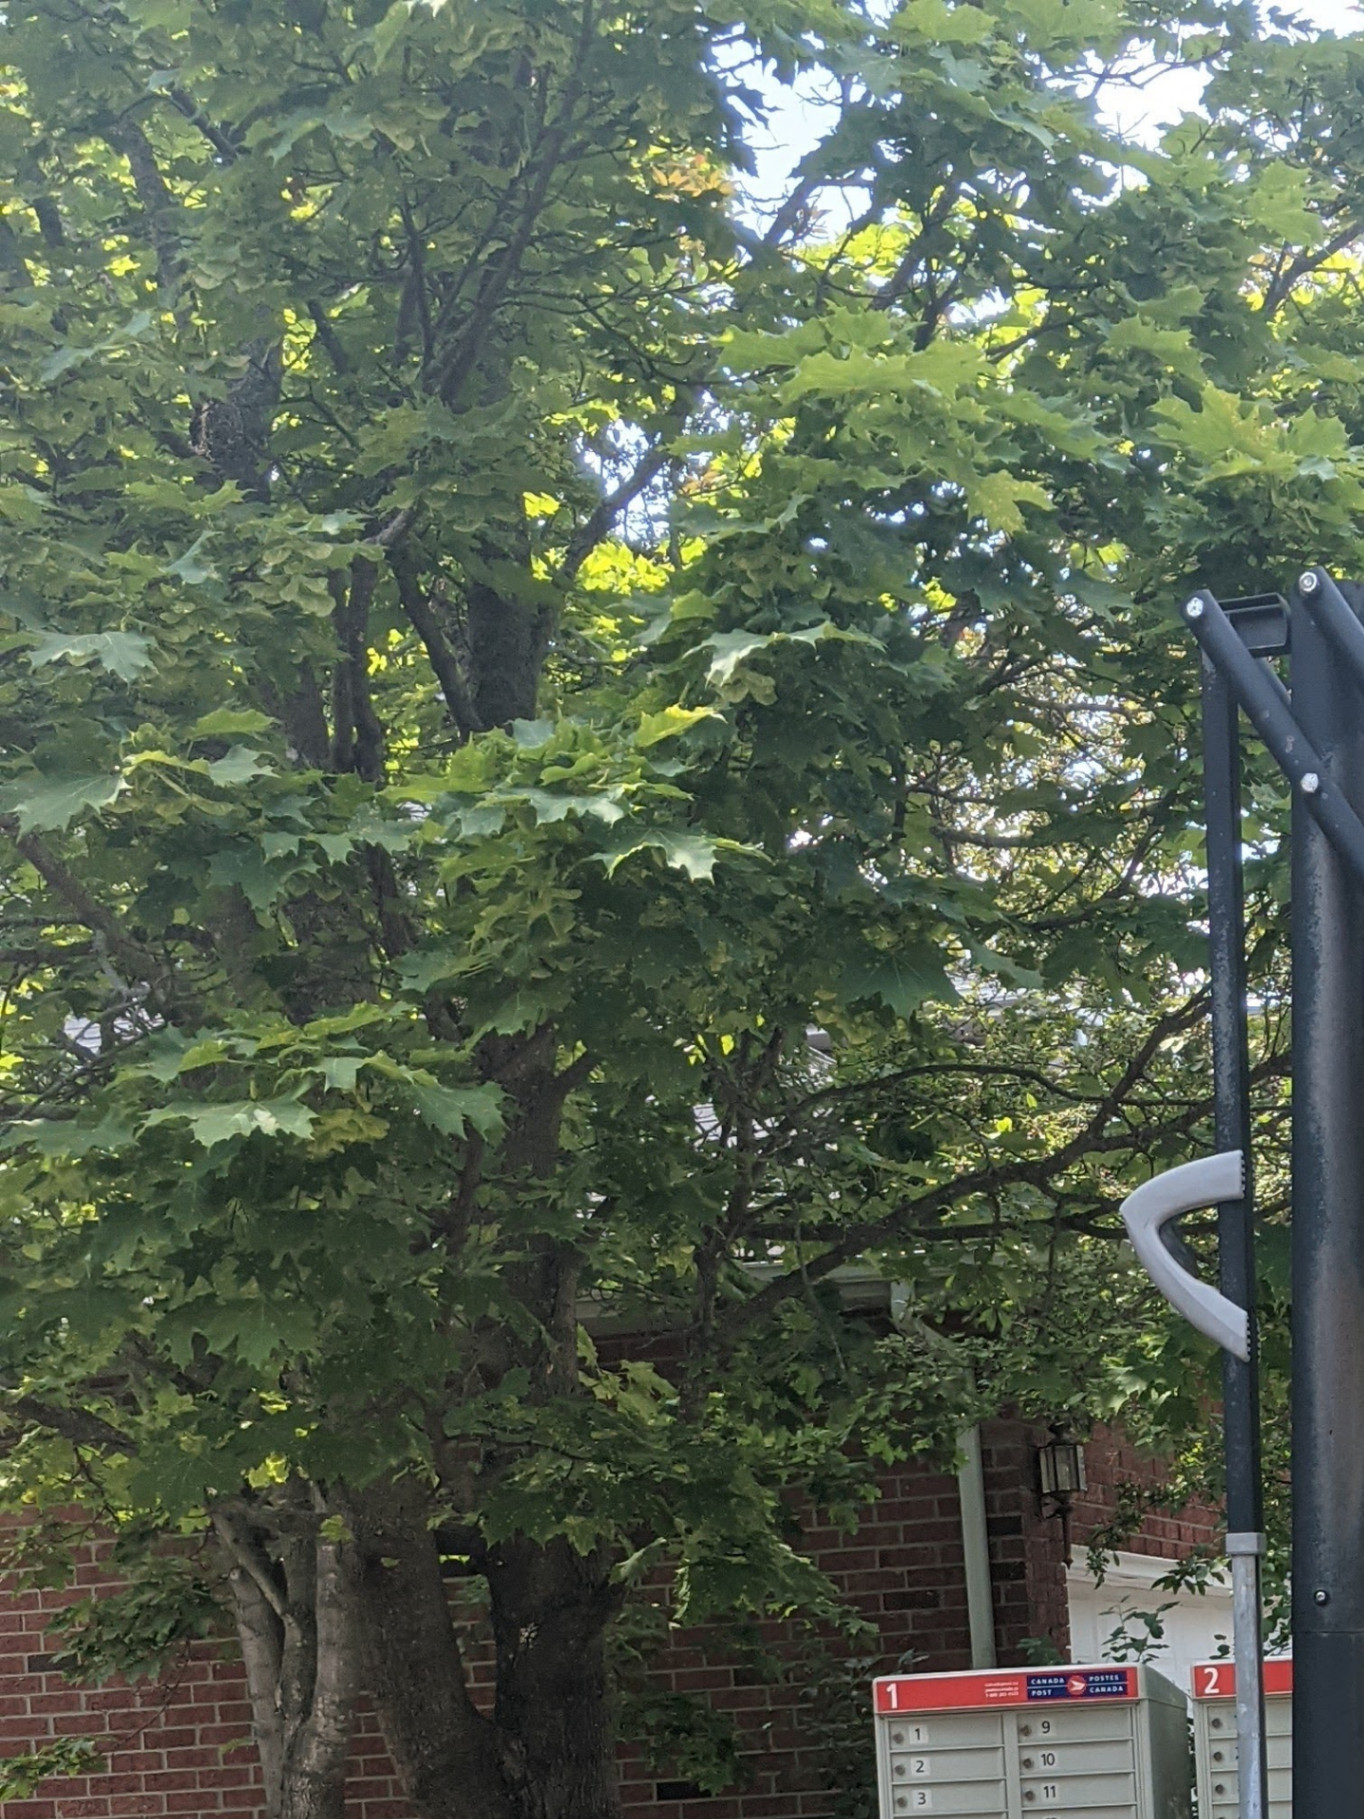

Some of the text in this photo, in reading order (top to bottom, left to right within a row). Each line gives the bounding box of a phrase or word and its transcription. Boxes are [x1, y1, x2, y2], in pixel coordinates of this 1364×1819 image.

[1030, 1677, 1065, 1686] CANADA
[1088, 1674, 1120, 1683] POSTES
[1203, 1667, 1220, 1694] 2
[885, 1683, 898, 1709] 1
[1031, 1688, 1052, 1697] POST
[1089, 1685, 1124, 1694] CANADA
[1041, 1720, 1051, 1734] 9
[1041, 1753, 1055, 1766] 10
[915, 1760, 925, 1773] 2
[1043, 1785, 1056, 1798] 11
[917, 1792, 926, 1805] 3
